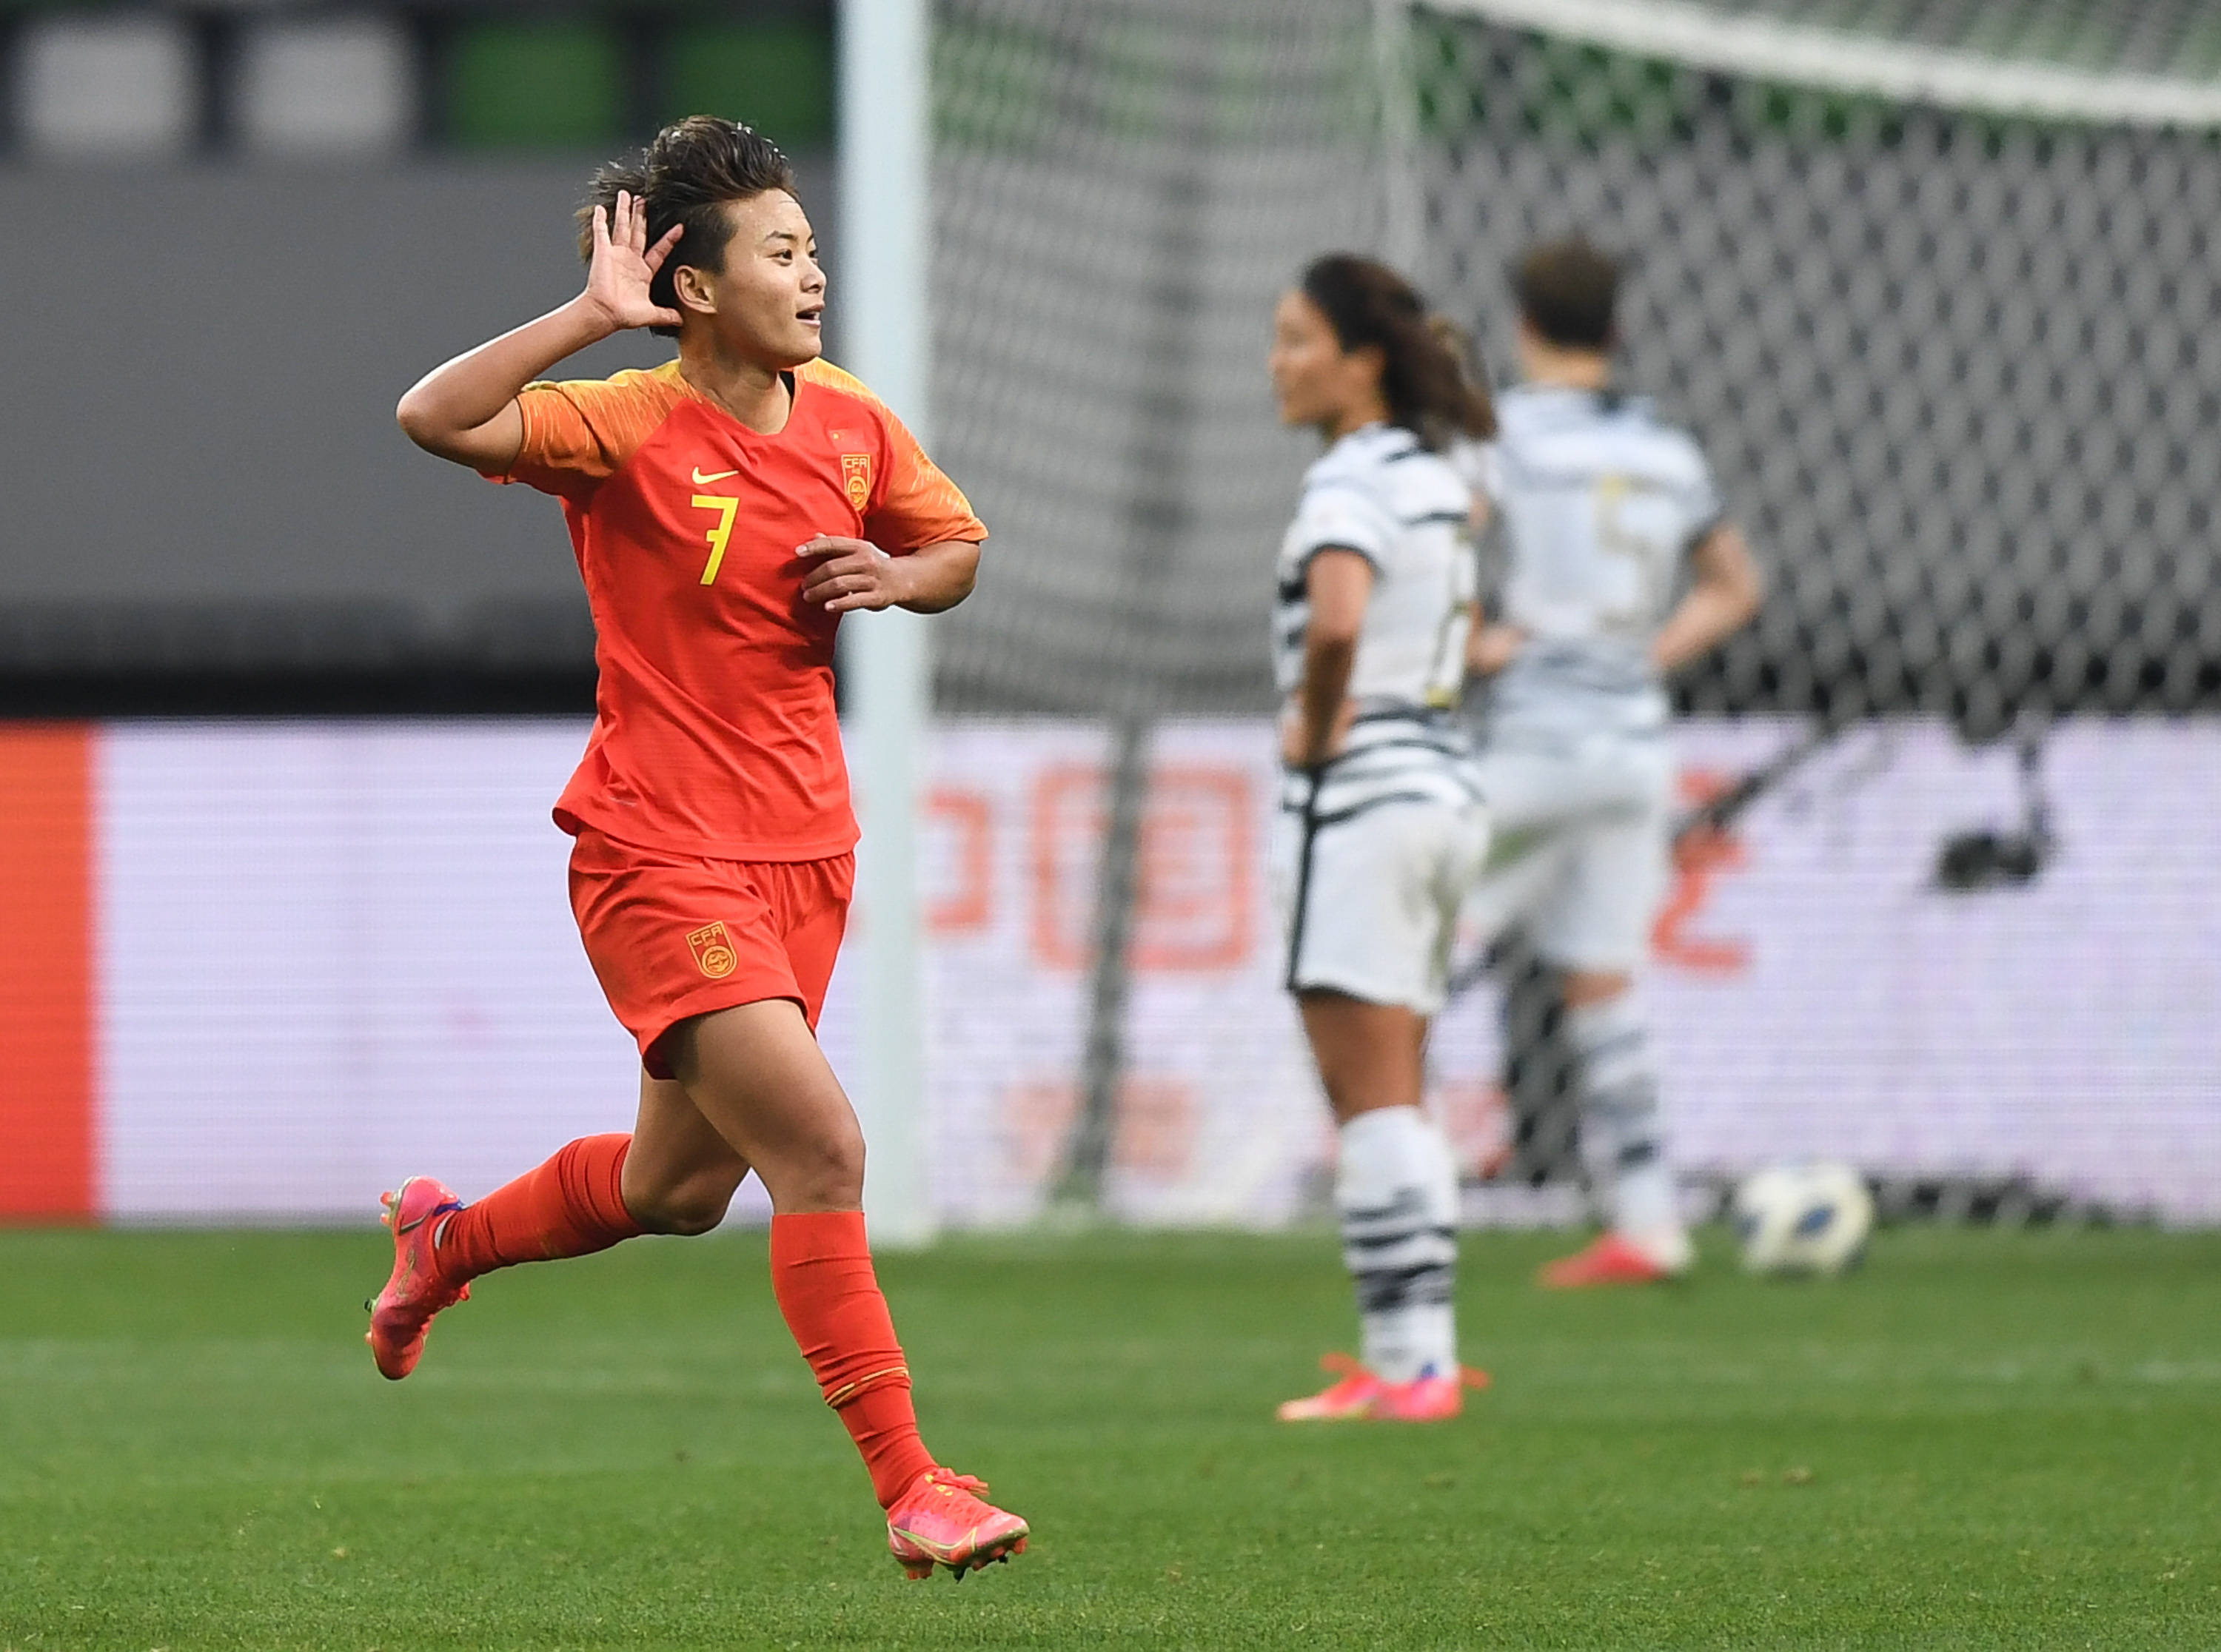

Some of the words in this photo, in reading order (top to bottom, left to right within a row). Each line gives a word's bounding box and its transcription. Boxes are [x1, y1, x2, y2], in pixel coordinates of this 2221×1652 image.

[844, 457, 867, 468] CFA
[691, 494, 740, 585] 7
[690, 925, 723, 946] CFA
